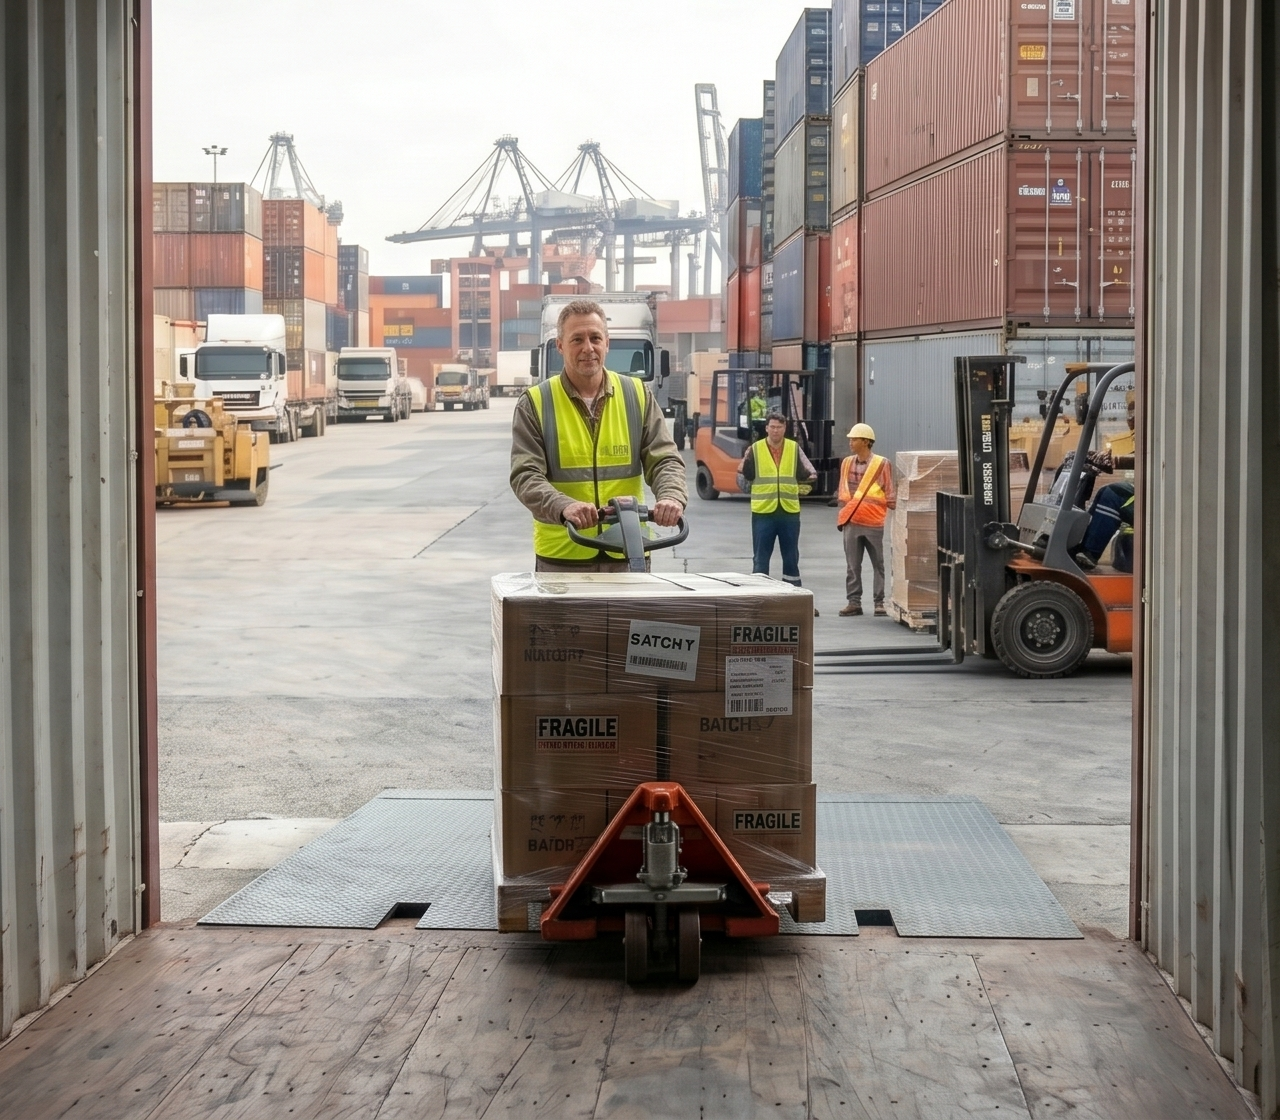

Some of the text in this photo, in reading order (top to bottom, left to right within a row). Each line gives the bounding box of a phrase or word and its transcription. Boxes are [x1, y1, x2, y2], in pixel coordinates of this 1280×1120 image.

[733, 626, 798, 643] FRAGILE
[538, 718, 617, 737] FRAGILE
[700, 716, 752, 732] BATCH
[735, 813, 801, 830] FRAGILE
